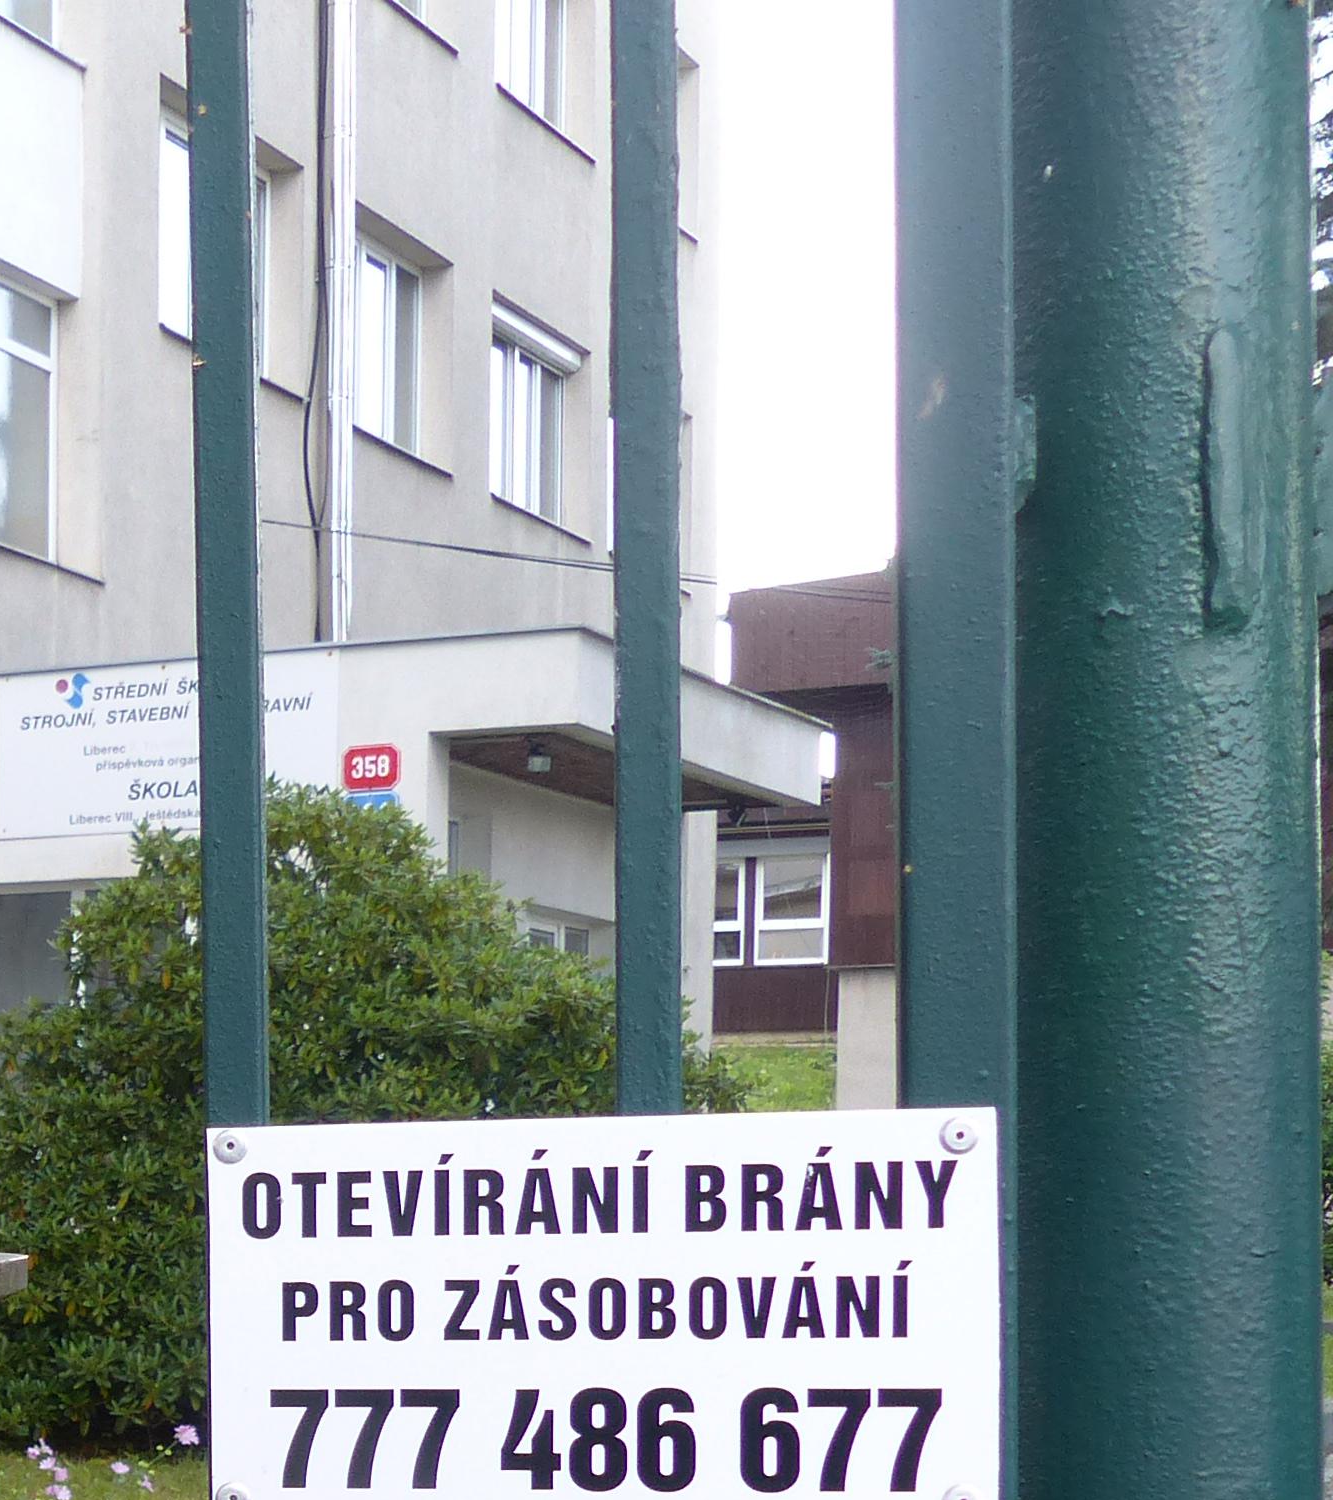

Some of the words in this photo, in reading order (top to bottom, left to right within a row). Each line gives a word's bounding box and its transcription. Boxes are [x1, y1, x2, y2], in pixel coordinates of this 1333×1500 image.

[93, 679, 169, 701] STŘEDNÍ
[21, 709, 96, 730] STROJNÍ,
[106, 702, 190, 724] STAVEBNÍ
[261, 692, 313, 713] RAVNÍ
[83, 745, 125, 756] Liberec
[351, 755, 390, 779] 358
[128, 779, 198, 800] ŠKOLA
[70, 813, 112, 825] Liberec
[243, 1149, 653, 1239] OTEVÍRÁNÍ
[684, 1145, 958, 1234] BRÁNY
[283, 1280, 414, 1341] PRO
[444, 1261, 912, 1340] ZÁSOBOVÁNÍ
[271, 1389, 460, 1489] 777
[501, 1388, 696, 1492] 486
[740, 1388, 942, 1493] 677
